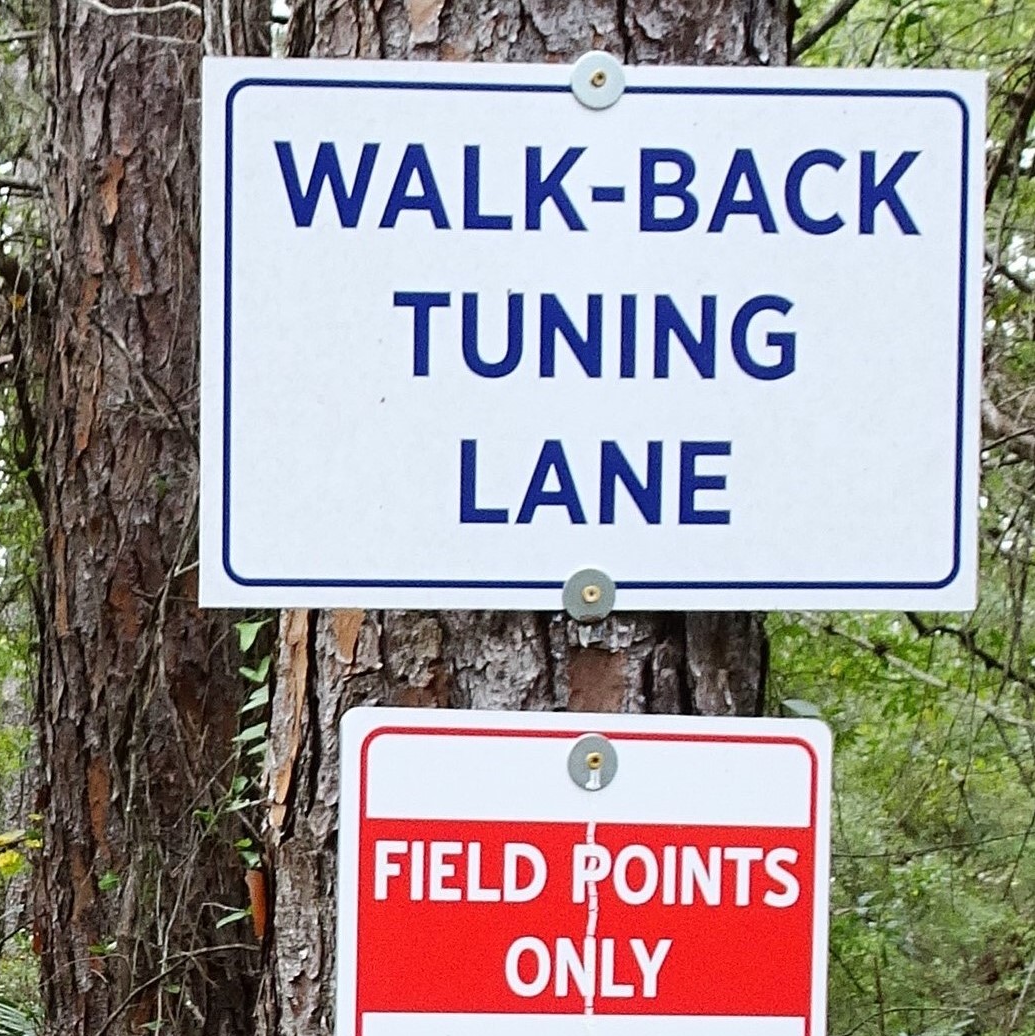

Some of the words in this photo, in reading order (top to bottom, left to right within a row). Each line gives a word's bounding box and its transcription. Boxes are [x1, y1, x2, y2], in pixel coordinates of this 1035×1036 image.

[274, 141, 921, 235] WALK-BACK
[393, 291, 796, 381] TUNING
[460, 439, 732, 525] LANE
[374, 840, 547, 903] FIELD
[571, 844, 800, 908] POINTS
[505, 936, 672, 999] ONLY
